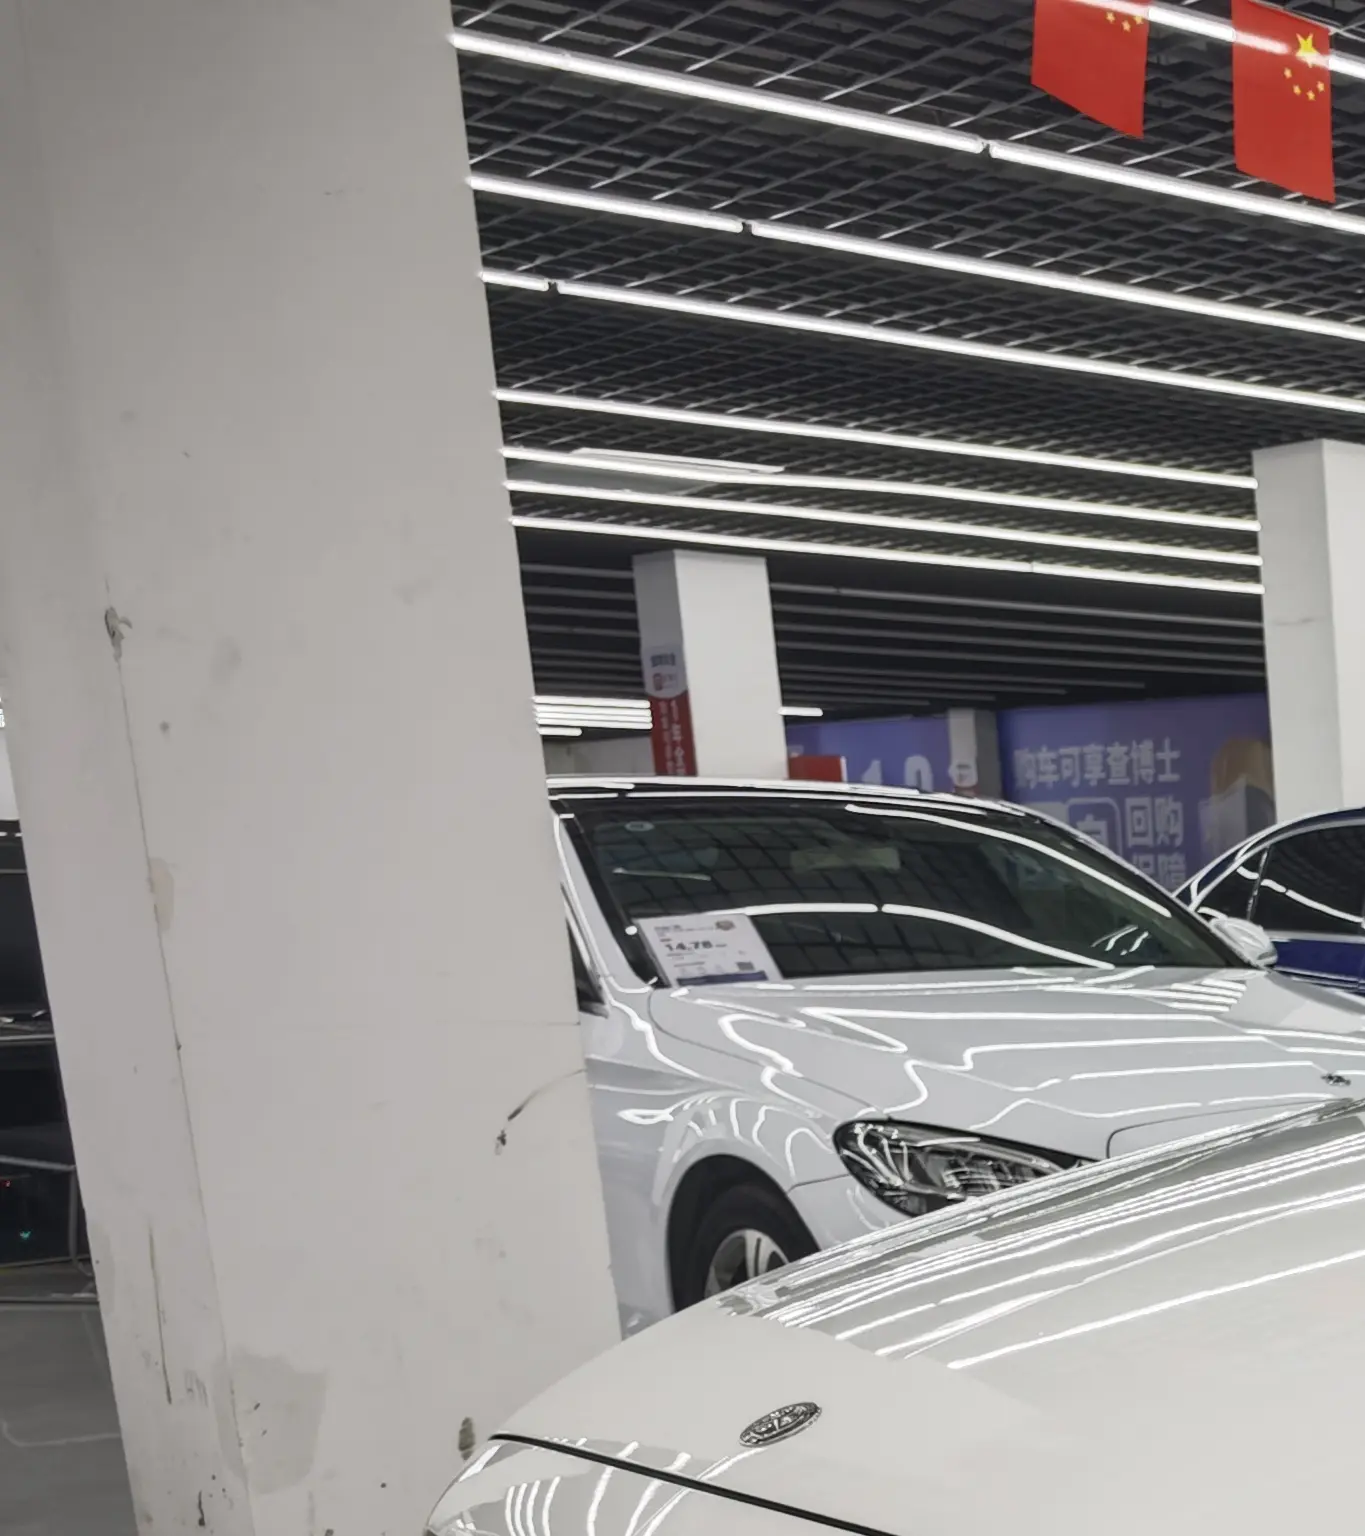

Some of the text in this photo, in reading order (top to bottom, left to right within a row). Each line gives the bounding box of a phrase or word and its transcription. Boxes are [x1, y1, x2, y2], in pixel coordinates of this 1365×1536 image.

[1014, 737, 1181, 789] 购车可享查博士
[1125, 795, 1184, 847] 回购
